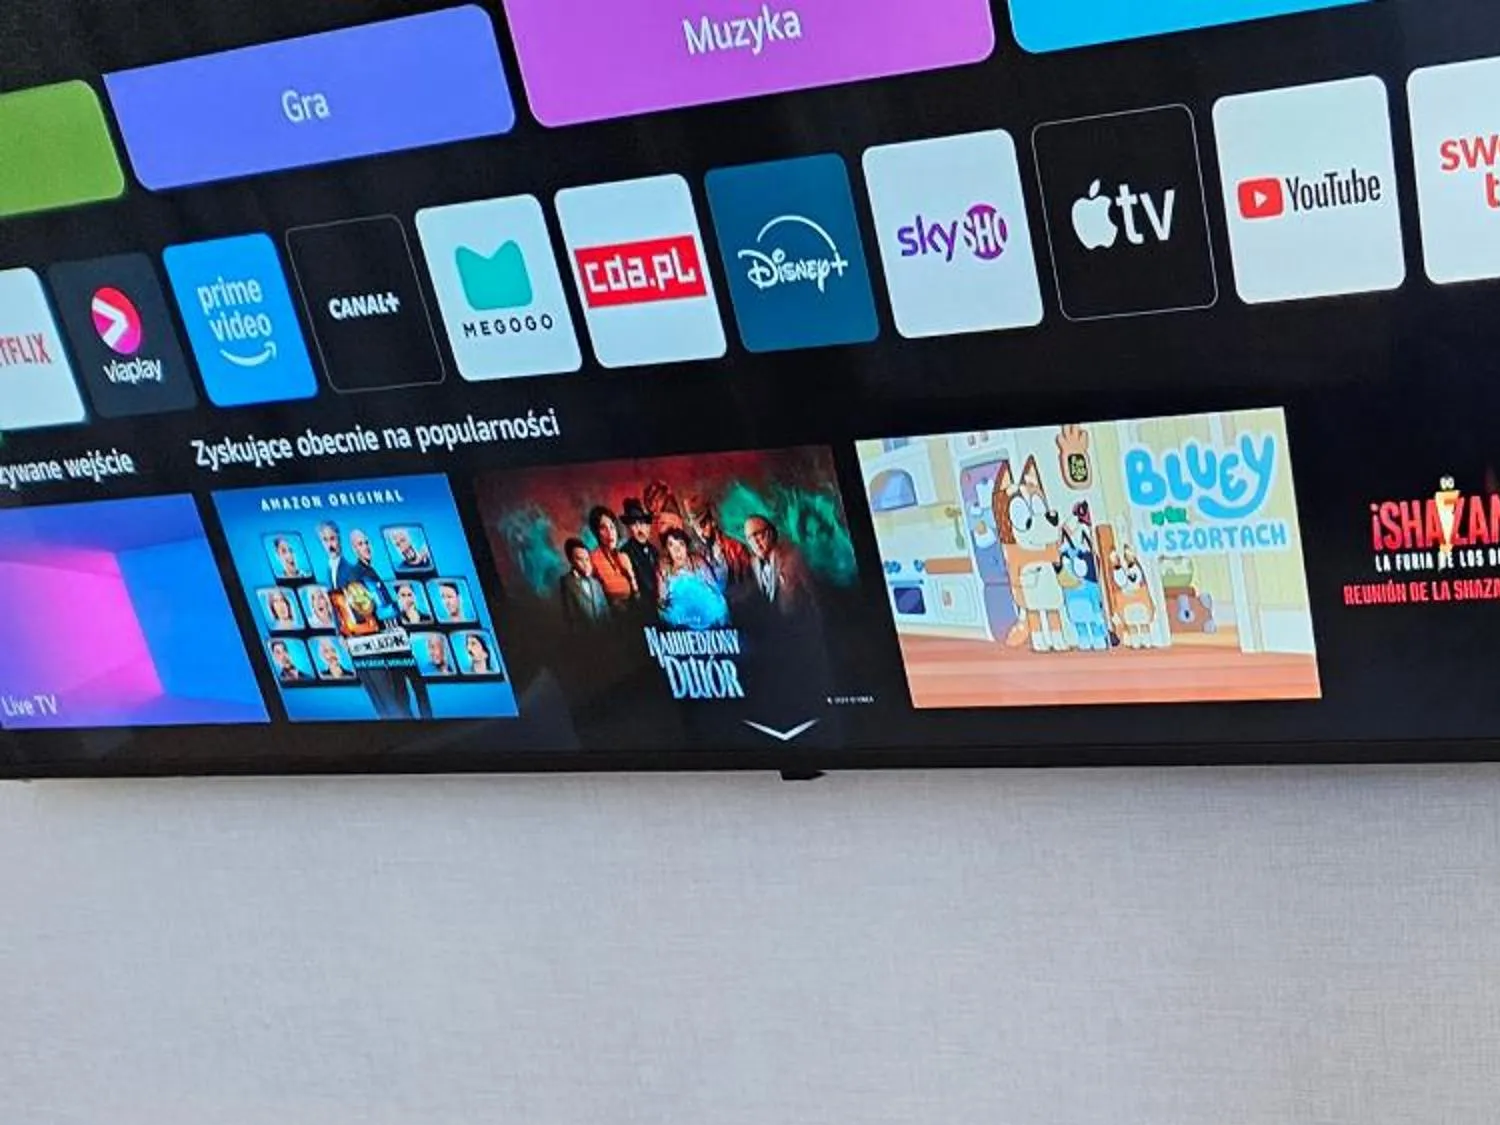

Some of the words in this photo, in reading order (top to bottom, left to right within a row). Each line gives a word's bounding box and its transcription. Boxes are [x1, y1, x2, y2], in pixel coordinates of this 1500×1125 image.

[683, 4, 802, 55] Muzyka
[281, 90, 331, 122] Gra
[1285, 168, 1382, 212] YouTube
[1116, 183, 1176, 244] tv
[197, 275, 263, 315] prime
[328, 291, 400, 320] CANAL+
[208, 310, 272, 342] video
[463, 313, 554, 338] MEGOGO
[0, 331, 52, 366] TFLIX
[103, 356, 162, 384] viaplay
[191, 433, 294, 471] Zyskujące
[296, 424, 380, 458] obecnie
[383, 427, 413, 450] na
[415, 407, 561, 453] popularności
[63, 447, 135, 482] wejście
[260, 497, 322, 512] AMAZON
[328, 488, 405, 509] ORIGINAL
[1163, 522, 1287, 550] SZORTACH
[1375, 554, 1392, 572] LA
[1396, 551, 1434, 571] FURIA
[1459, 547, 1485, 568] LOS
[1343, 580, 1408, 606] REUNIÓN
[1410, 580, 1430, 602] DE
[1432, 580, 1451, 601] LA
[1, 695, 34, 717] Live
[33, 694, 58, 716] TV
